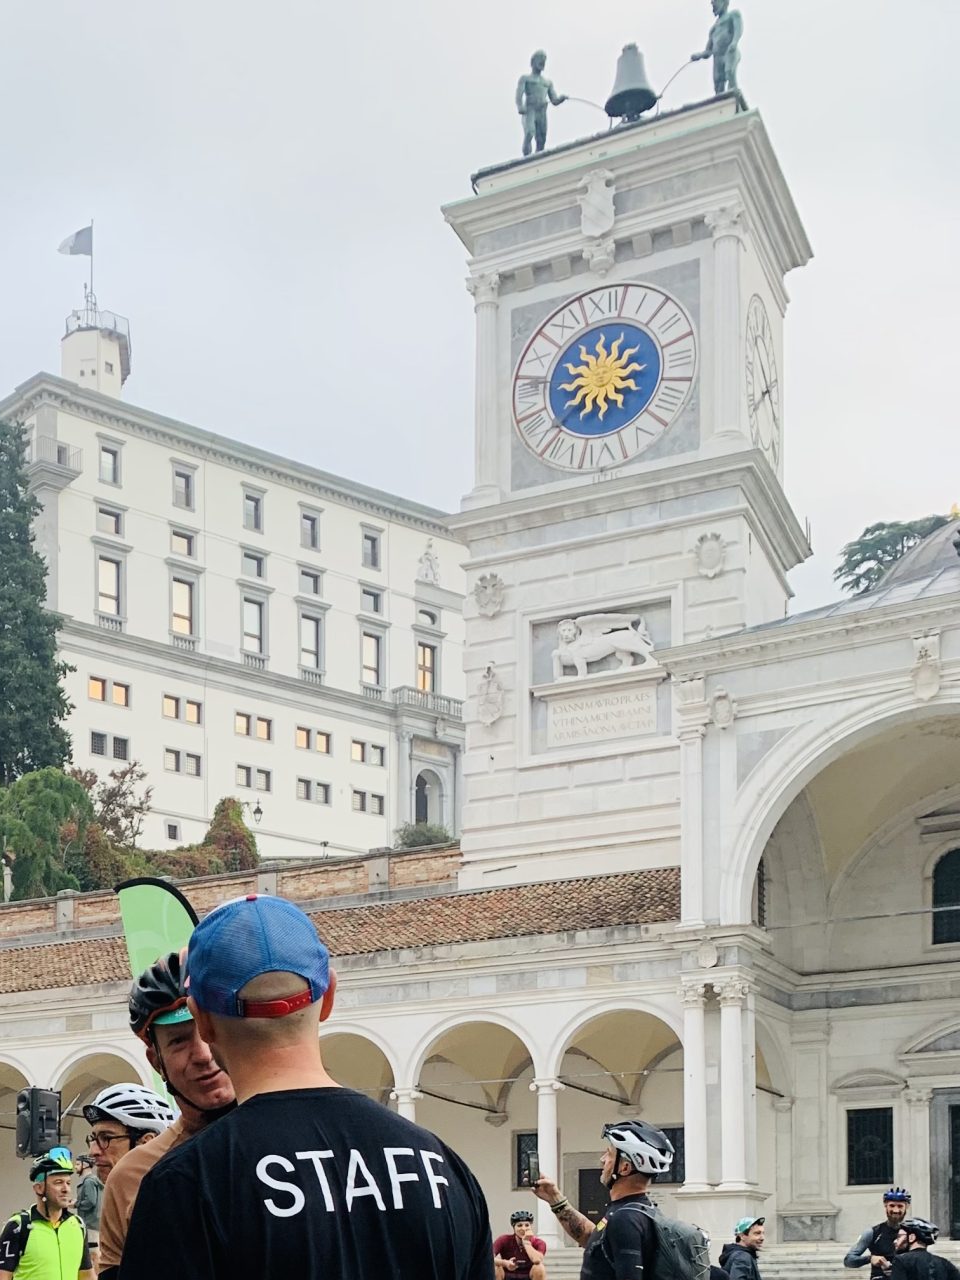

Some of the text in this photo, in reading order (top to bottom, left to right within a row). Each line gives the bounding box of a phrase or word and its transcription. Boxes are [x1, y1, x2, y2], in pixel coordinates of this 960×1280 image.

[589, 289, 618, 318] XII
[550, 308, 581, 339] XI
[658, 312, 682, 334] II
[526, 347, 552, 369] X
[669, 348, 692, 369] III
[256, 1147, 449, 1218] STAFF
